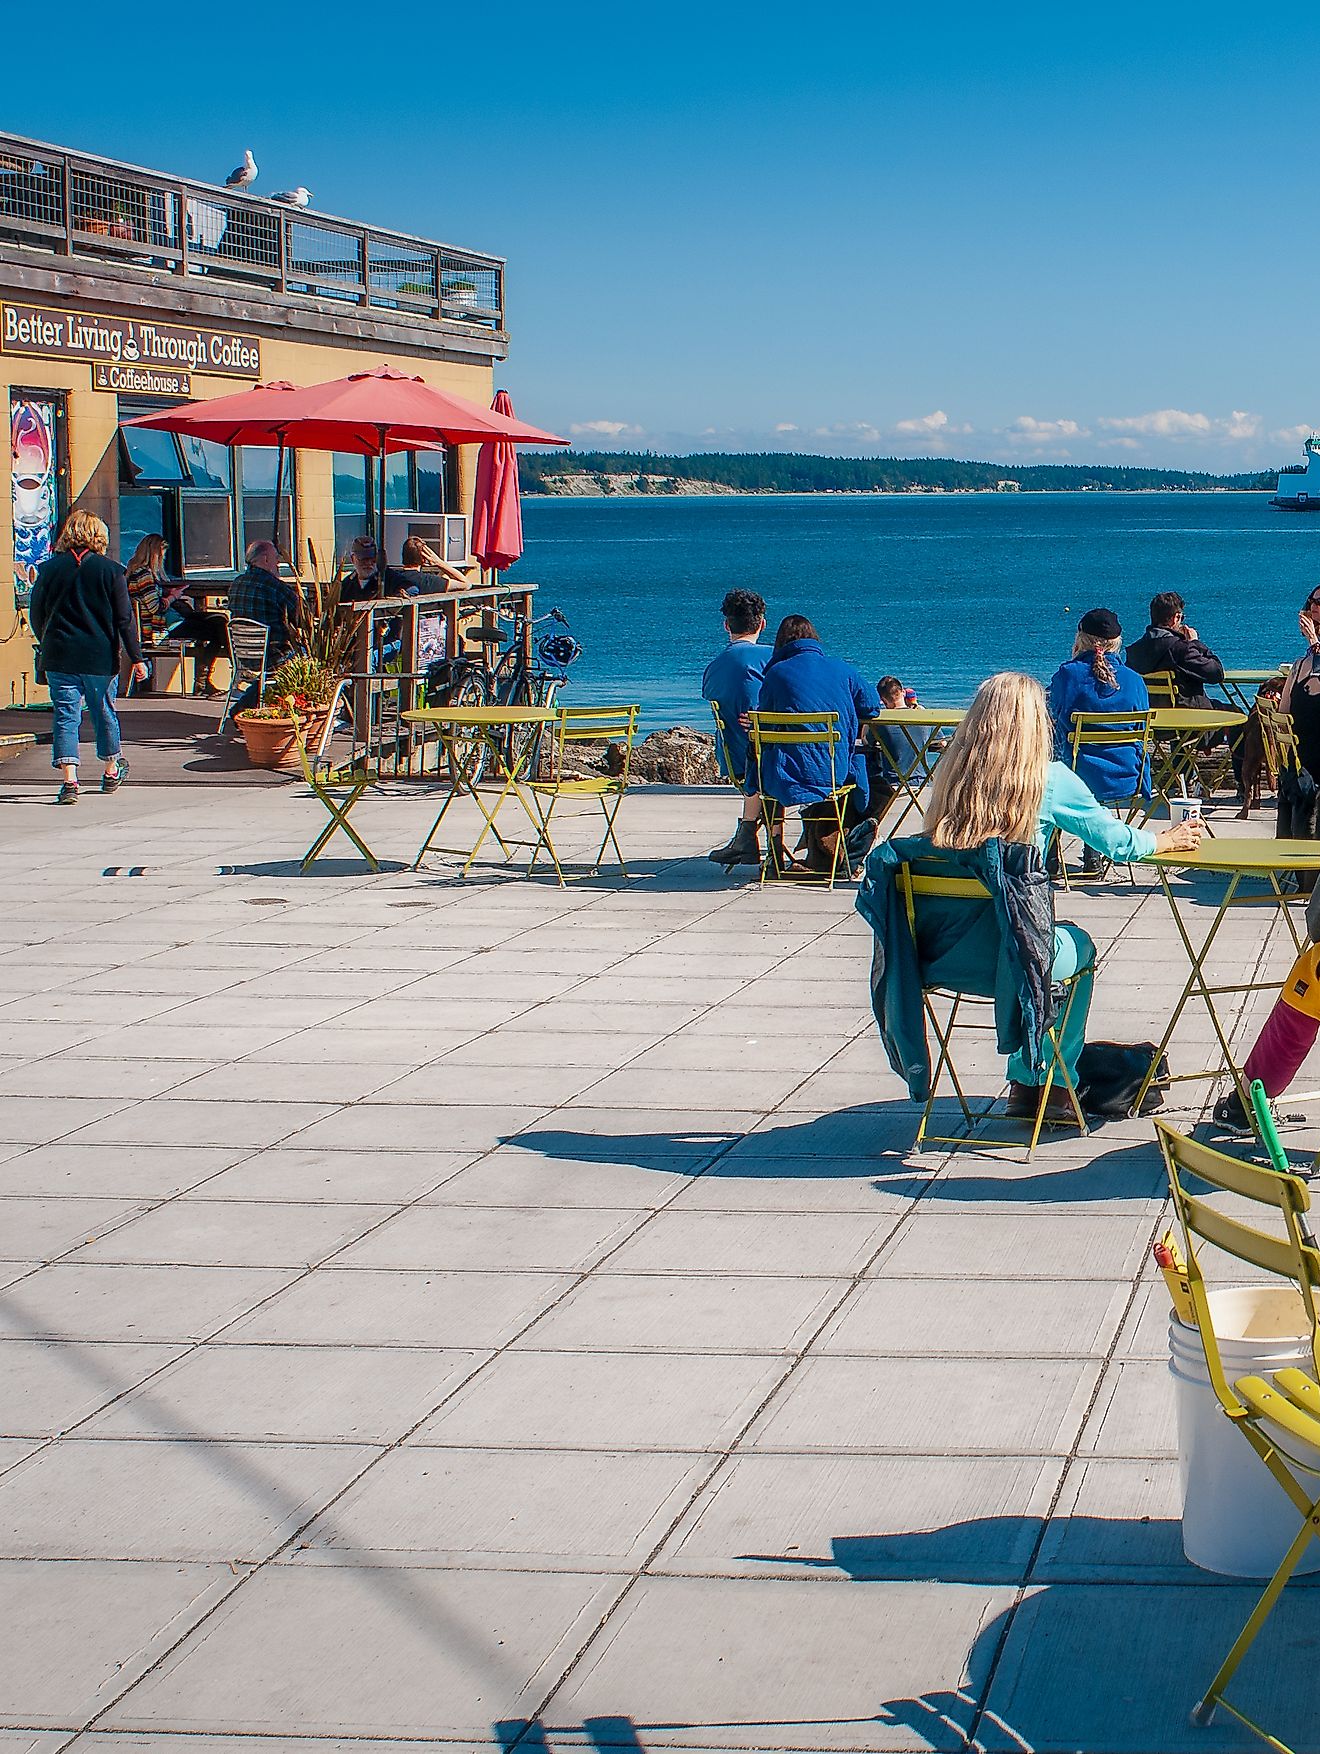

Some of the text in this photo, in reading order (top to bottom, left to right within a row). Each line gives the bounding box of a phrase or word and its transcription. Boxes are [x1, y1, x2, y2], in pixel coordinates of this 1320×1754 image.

[4, 307, 259, 370] Better Living Through Coffee
[109, 367, 179, 393] Coffeehouse
